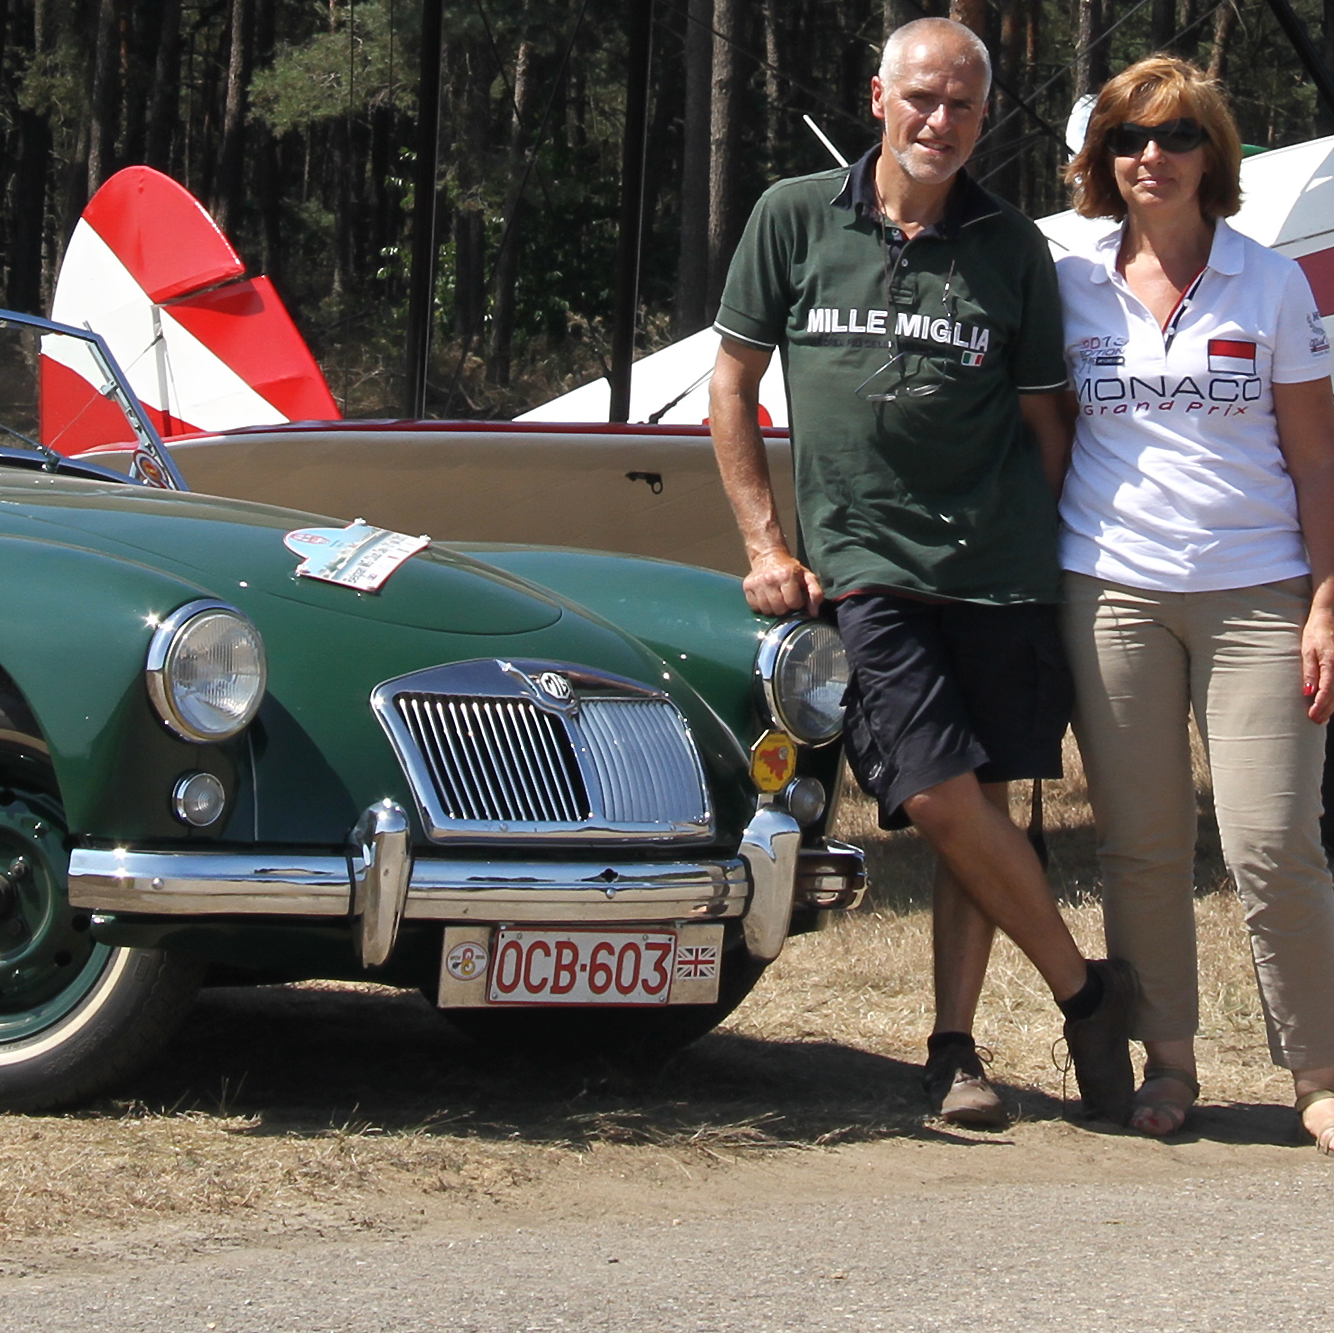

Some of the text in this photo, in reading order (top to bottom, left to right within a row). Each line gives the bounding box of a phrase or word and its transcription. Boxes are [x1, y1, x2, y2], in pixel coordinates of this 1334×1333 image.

[807, 308, 888, 334] MILLE
[894, 312, 990, 352] MIGLIA
[1084, 400, 1249, 416] Grand Prix
[543, 673, 569, 697] MG
